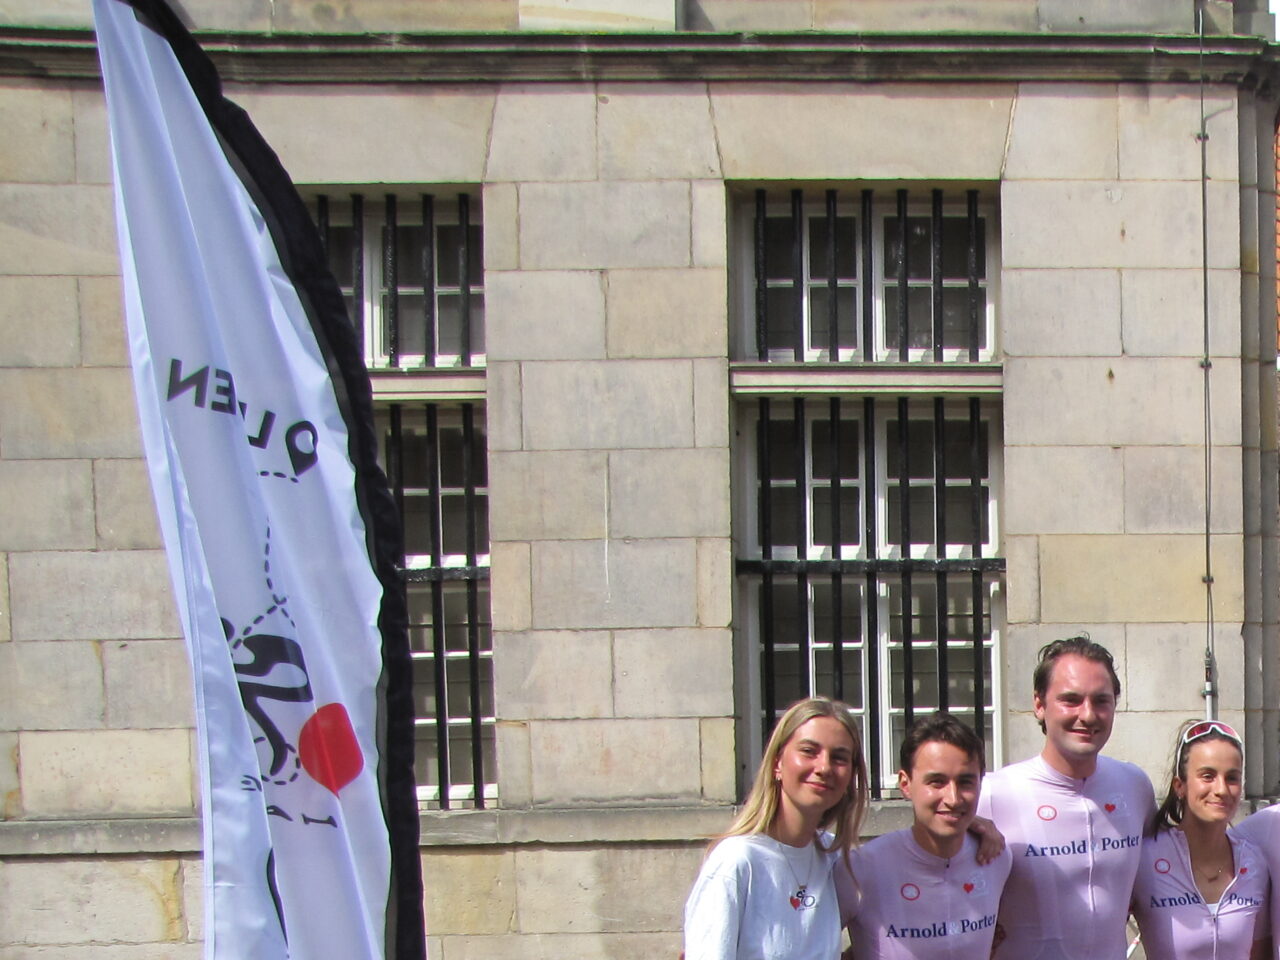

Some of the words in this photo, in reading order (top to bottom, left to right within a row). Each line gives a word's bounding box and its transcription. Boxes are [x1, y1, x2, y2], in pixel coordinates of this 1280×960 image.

[1024, 840, 1087, 857] Arnold
[1101, 835, 1140, 851] Porter
[1150, 893, 1201, 908] Arnold
[886, 922, 947, 938] Arnold
[961, 914, 997, 933] Porter
